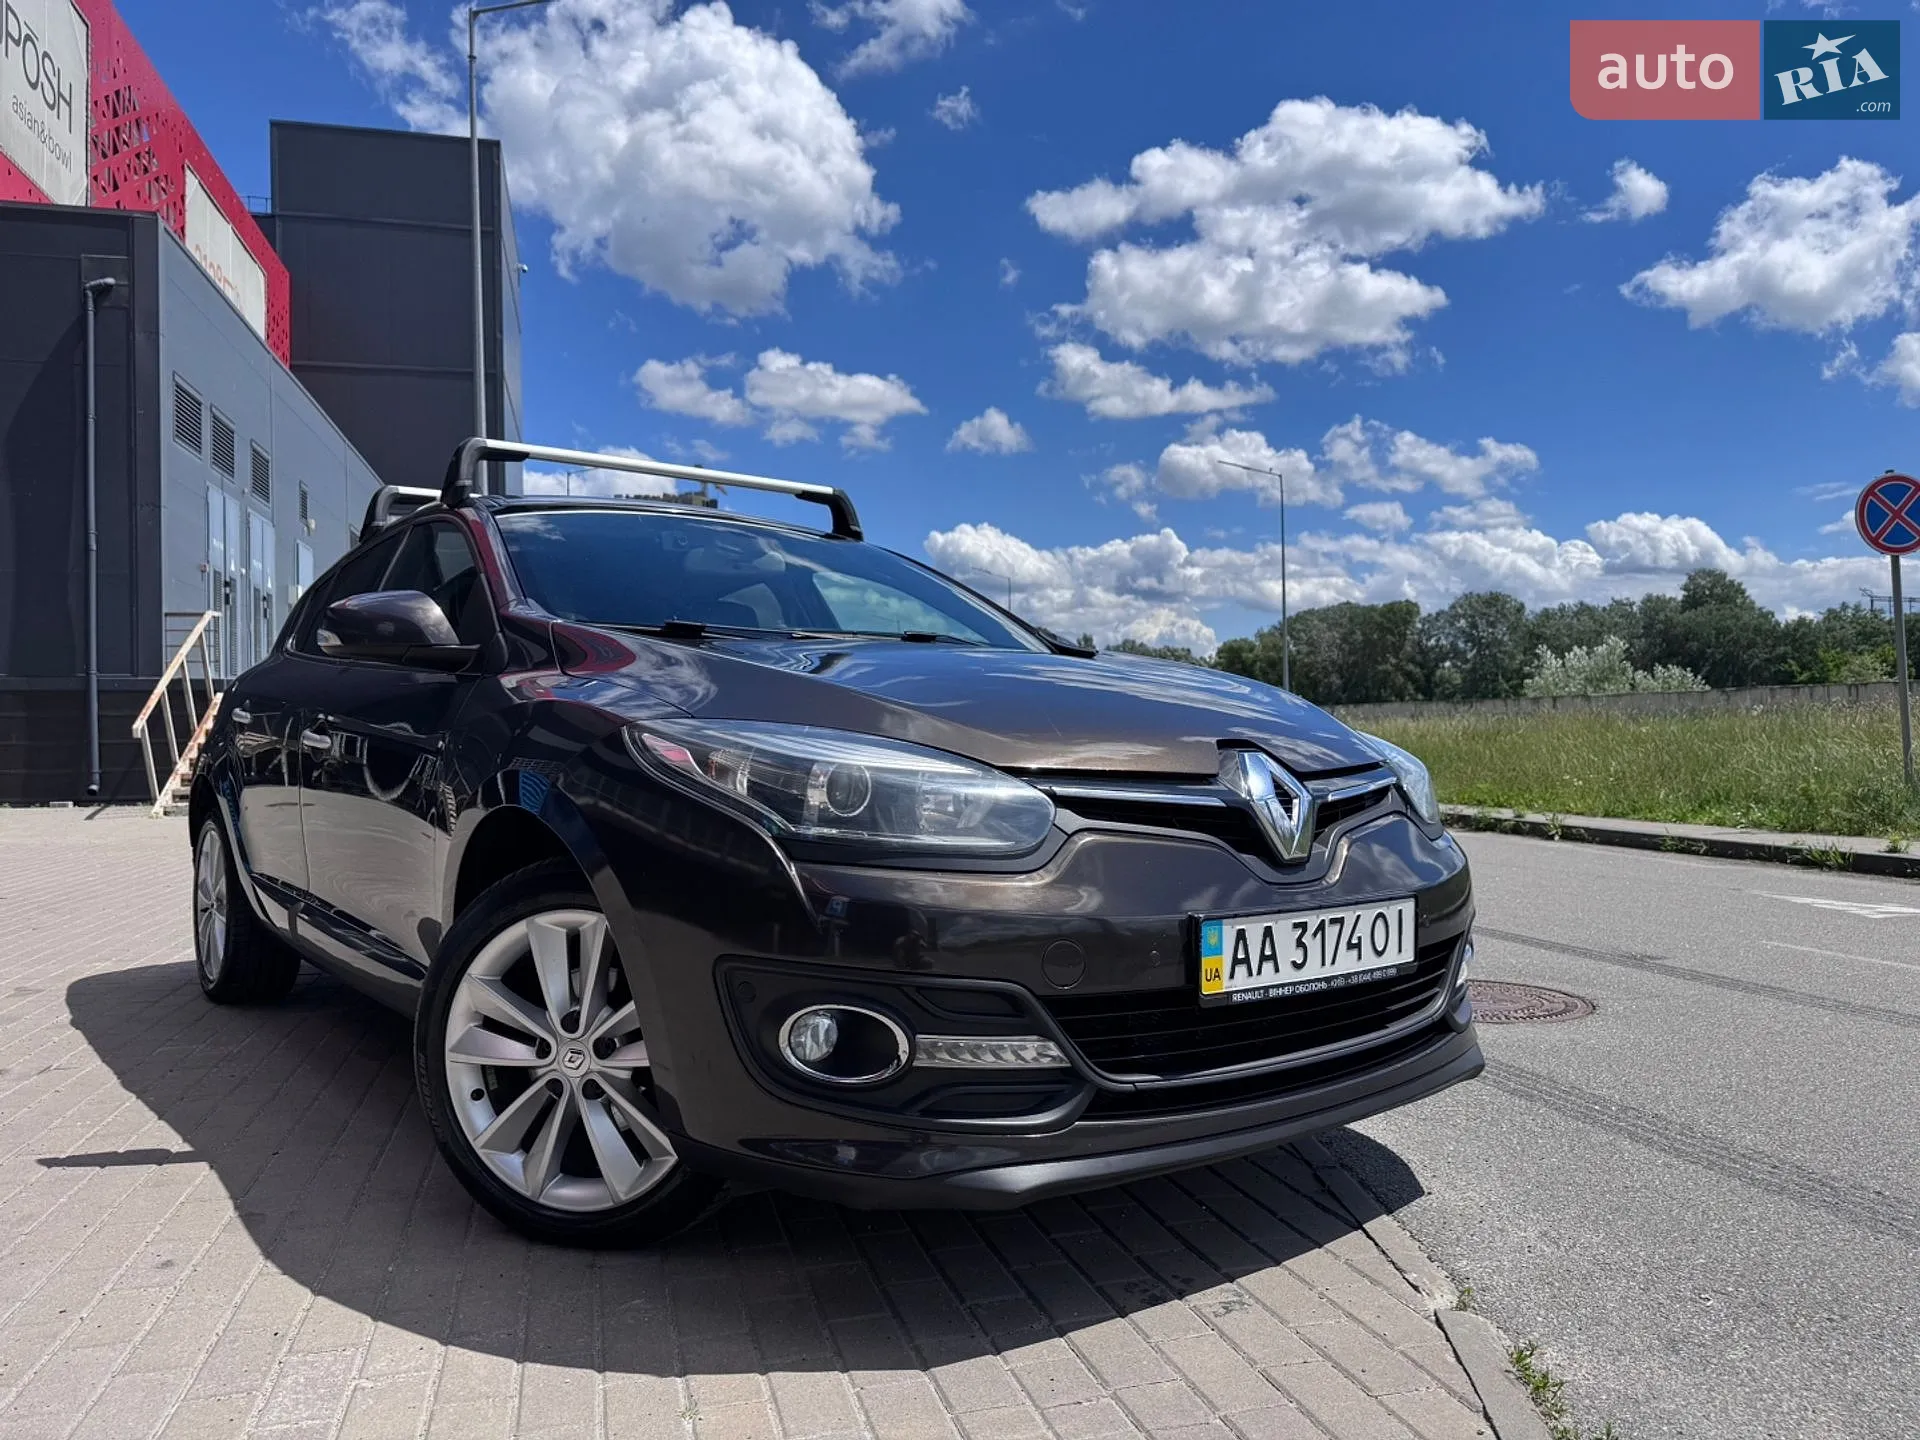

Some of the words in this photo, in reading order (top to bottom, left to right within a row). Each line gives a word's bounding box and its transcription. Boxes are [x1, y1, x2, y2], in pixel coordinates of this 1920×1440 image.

[11, 94, 72, 173] asian&bowl
[1205, 967, 1221, 982] UA
[1232, 989, 1264, 1003] RENAULT
